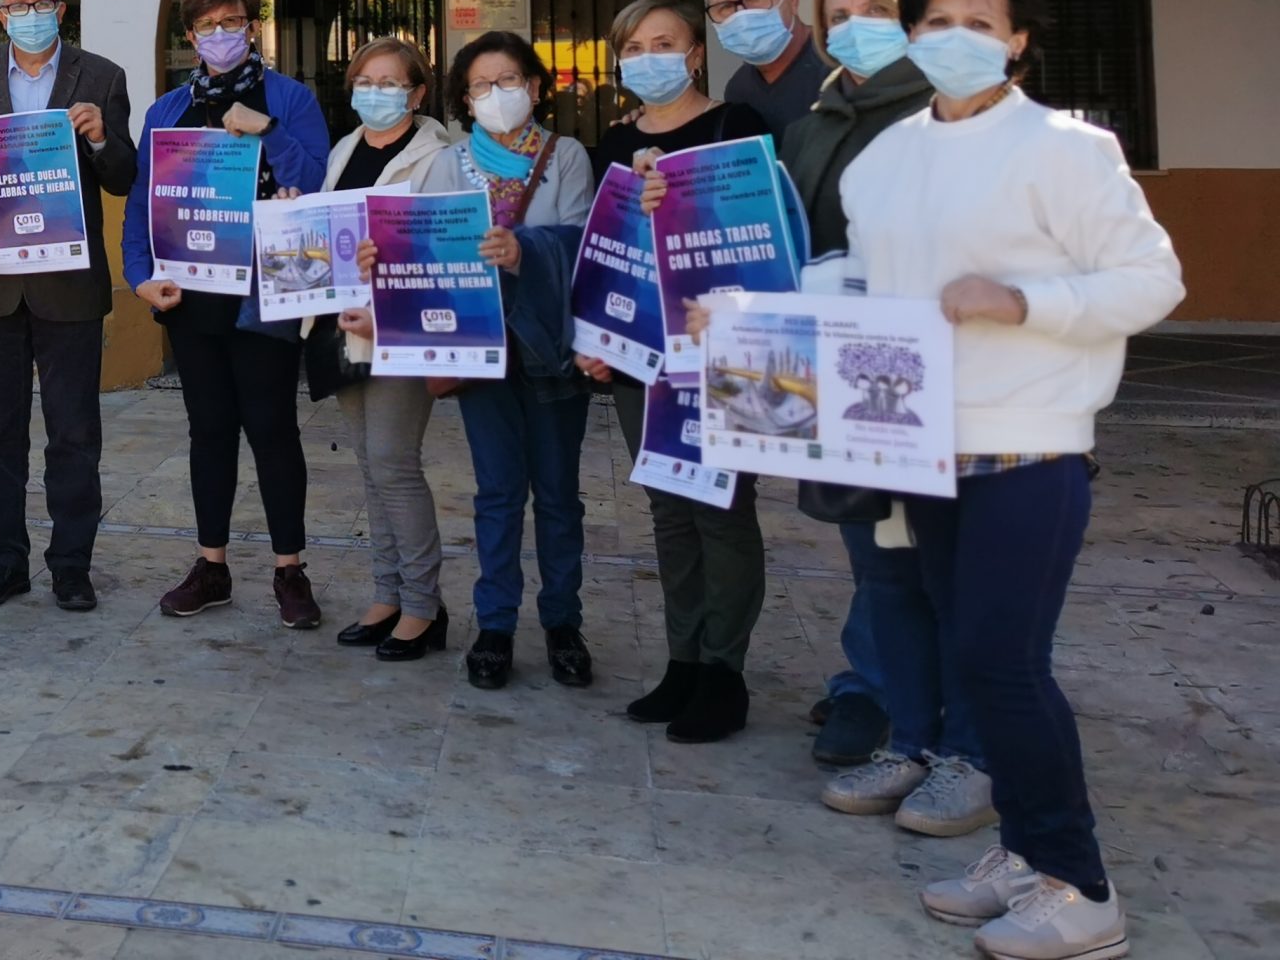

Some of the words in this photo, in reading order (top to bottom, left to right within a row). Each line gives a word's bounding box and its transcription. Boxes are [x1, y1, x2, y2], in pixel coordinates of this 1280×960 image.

[20, 171, 37, 183] QUE
[28, 183, 46, 195] QUE
[46, 180, 76, 194] HIERAN
[154, 185, 188, 198] QUIERO
[22, 214, 41, 225] 016
[178, 208, 190, 221] NO
[193, 209, 250, 224] SOBREVIVIR
[196, 232, 212, 241] 016
[666, 234, 681, 251] NO
[684, 229, 722, 248] HAGAS
[724, 223, 771, 243] TRATOS
[591, 232, 599, 246] NI
[598, 235, 626, 256] GOLPES
[626, 246, 643, 262] QUE
[584, 246, 593, 260] NI
[593, 249, 631, 273] PALABRAS
[630, 263, 648, 280] QUE
[669, 253, 692, 271] CON
[694, 251, 709, 268] EL
[711, 243, 776, 266] MALTRATO
[378, 262, 387, 275] NI
[389, 262, 424, 275] GOLPES
[426, 262, 445, 275] QUE
[376, 277, 386, 290] NI
[387, 277, 435, 290] PALABRAS
[437, 277, 456, 289] QUE
[458, 276, 492, 289] HIERAN
[615, 296, 633, 311] 016
[430, 311, 452, 321] 016
